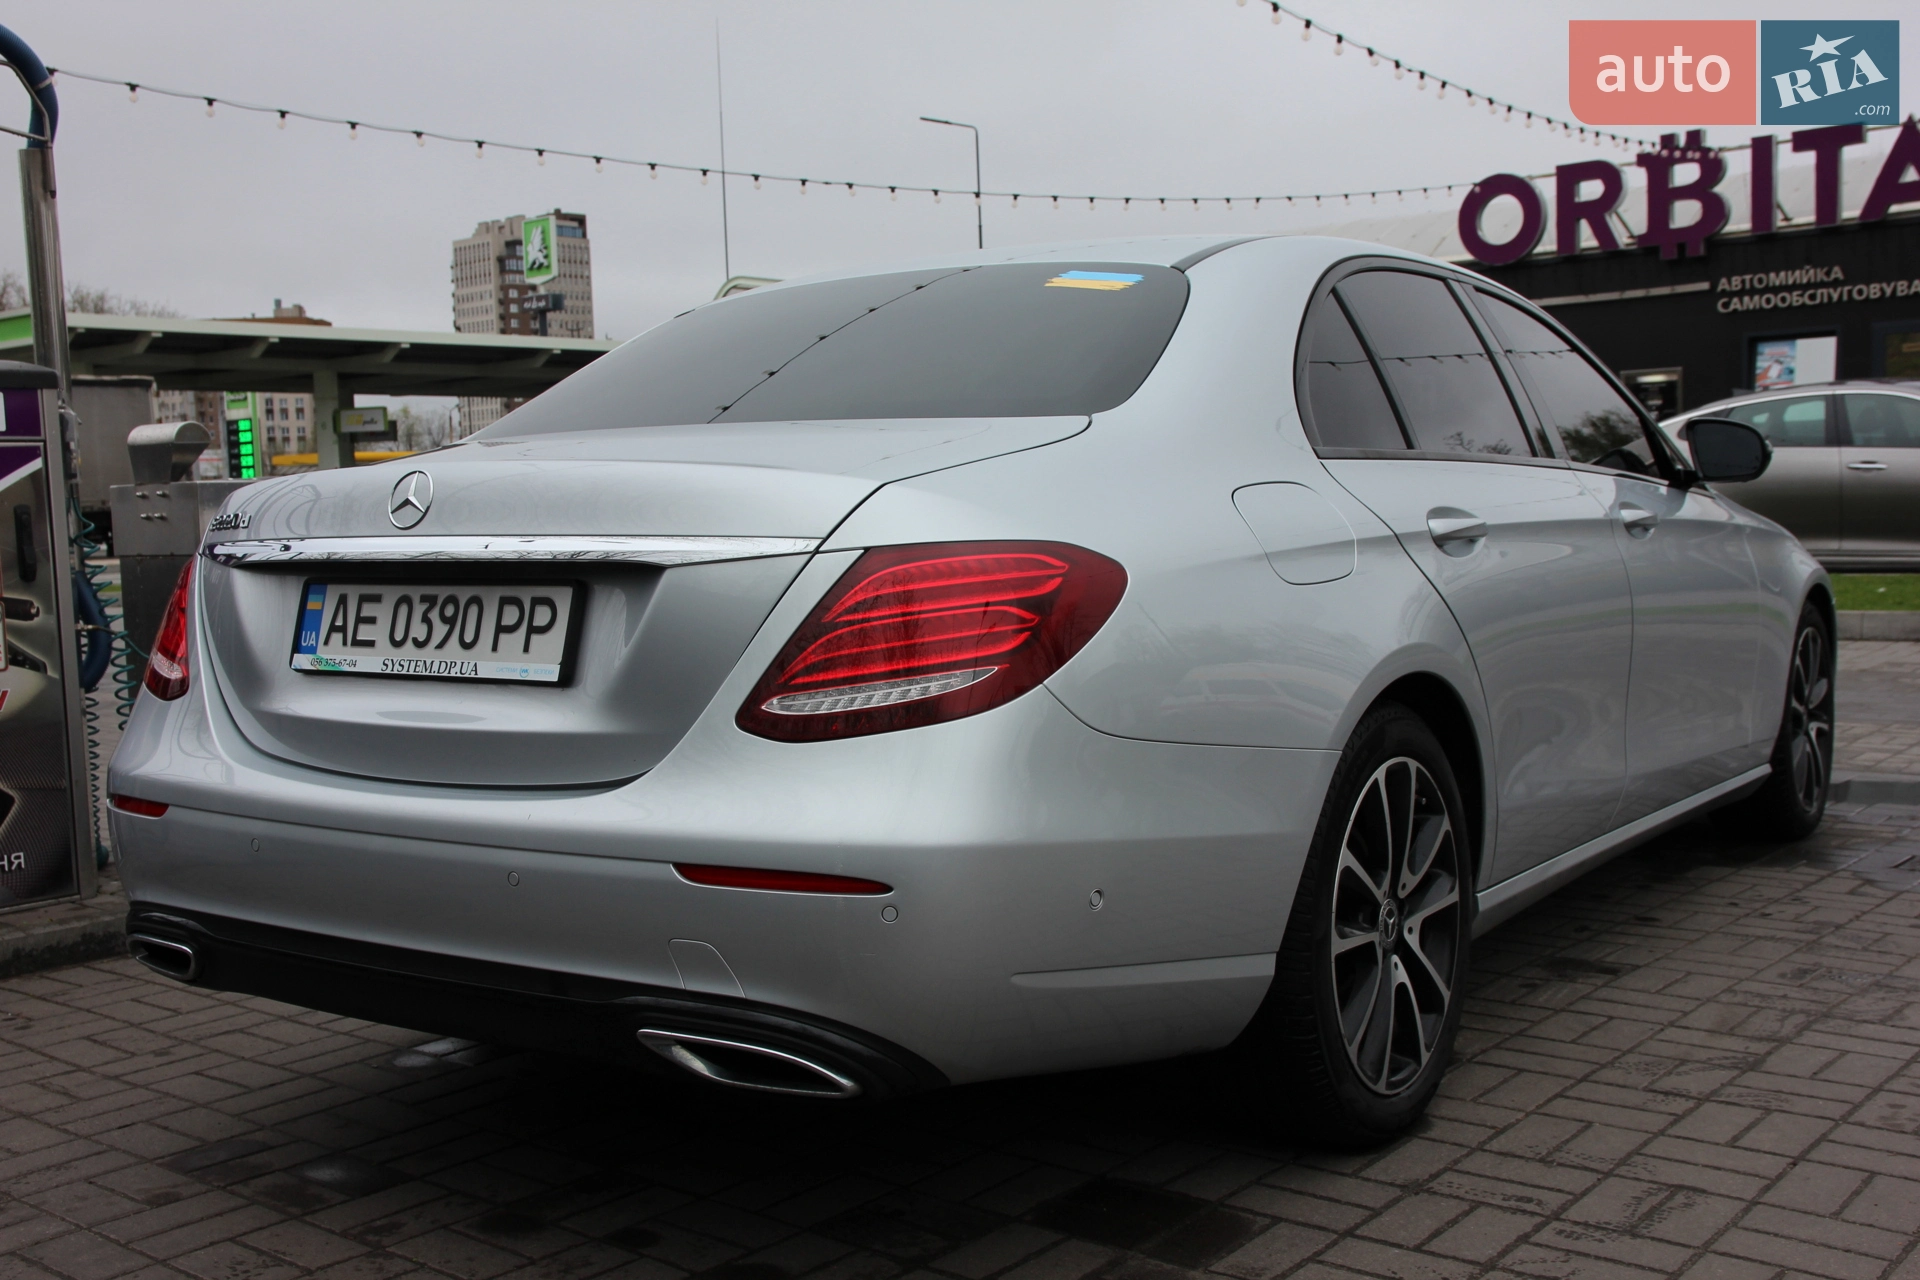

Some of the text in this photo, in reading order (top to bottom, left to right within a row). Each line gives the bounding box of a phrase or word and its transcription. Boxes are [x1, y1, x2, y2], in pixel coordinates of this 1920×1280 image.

[1717, 265, 1844, 292] АВТОМИЙКА
[322, 593, 558, 654] AE 0390 PP
[301, 630, 316, 647] UA
[381, 657, 479, 676] SYSTEM.DP.UA
